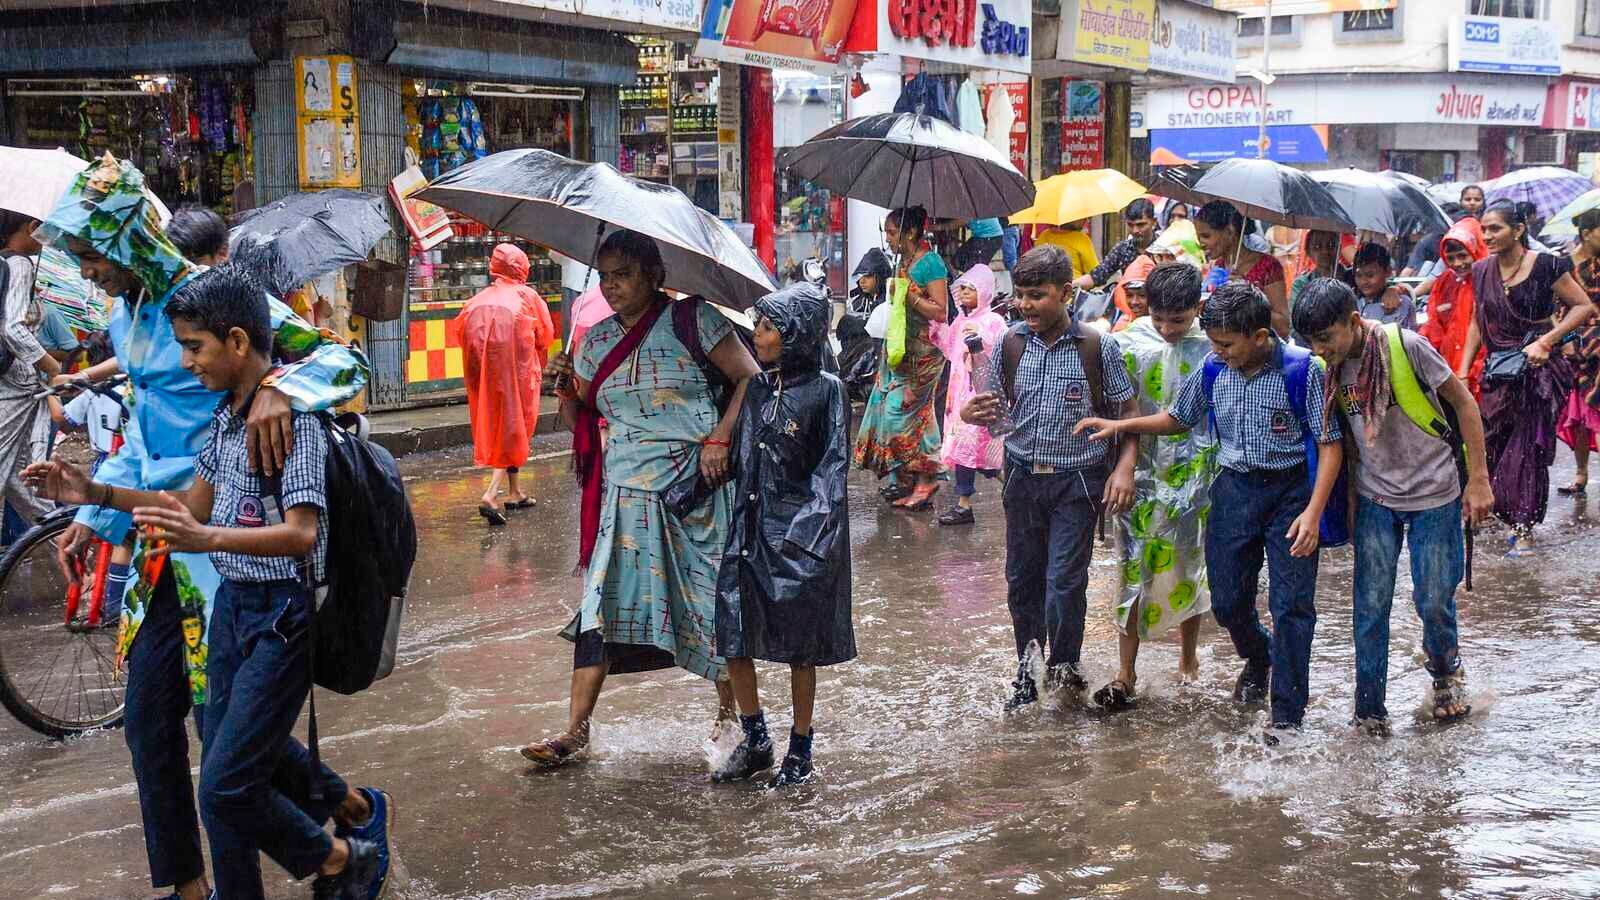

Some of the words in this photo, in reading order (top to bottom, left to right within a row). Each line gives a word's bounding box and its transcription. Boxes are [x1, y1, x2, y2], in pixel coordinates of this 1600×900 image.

[743, 52, 772, 65] MATANGI
[772, 57, 802, 70] TOBACCO
[1187, 85, 1272, 110] GOPAL
[1436, 84, 1485, 120] ગોપાલ
[1168, 111, 1253, 127] STATIONERY
